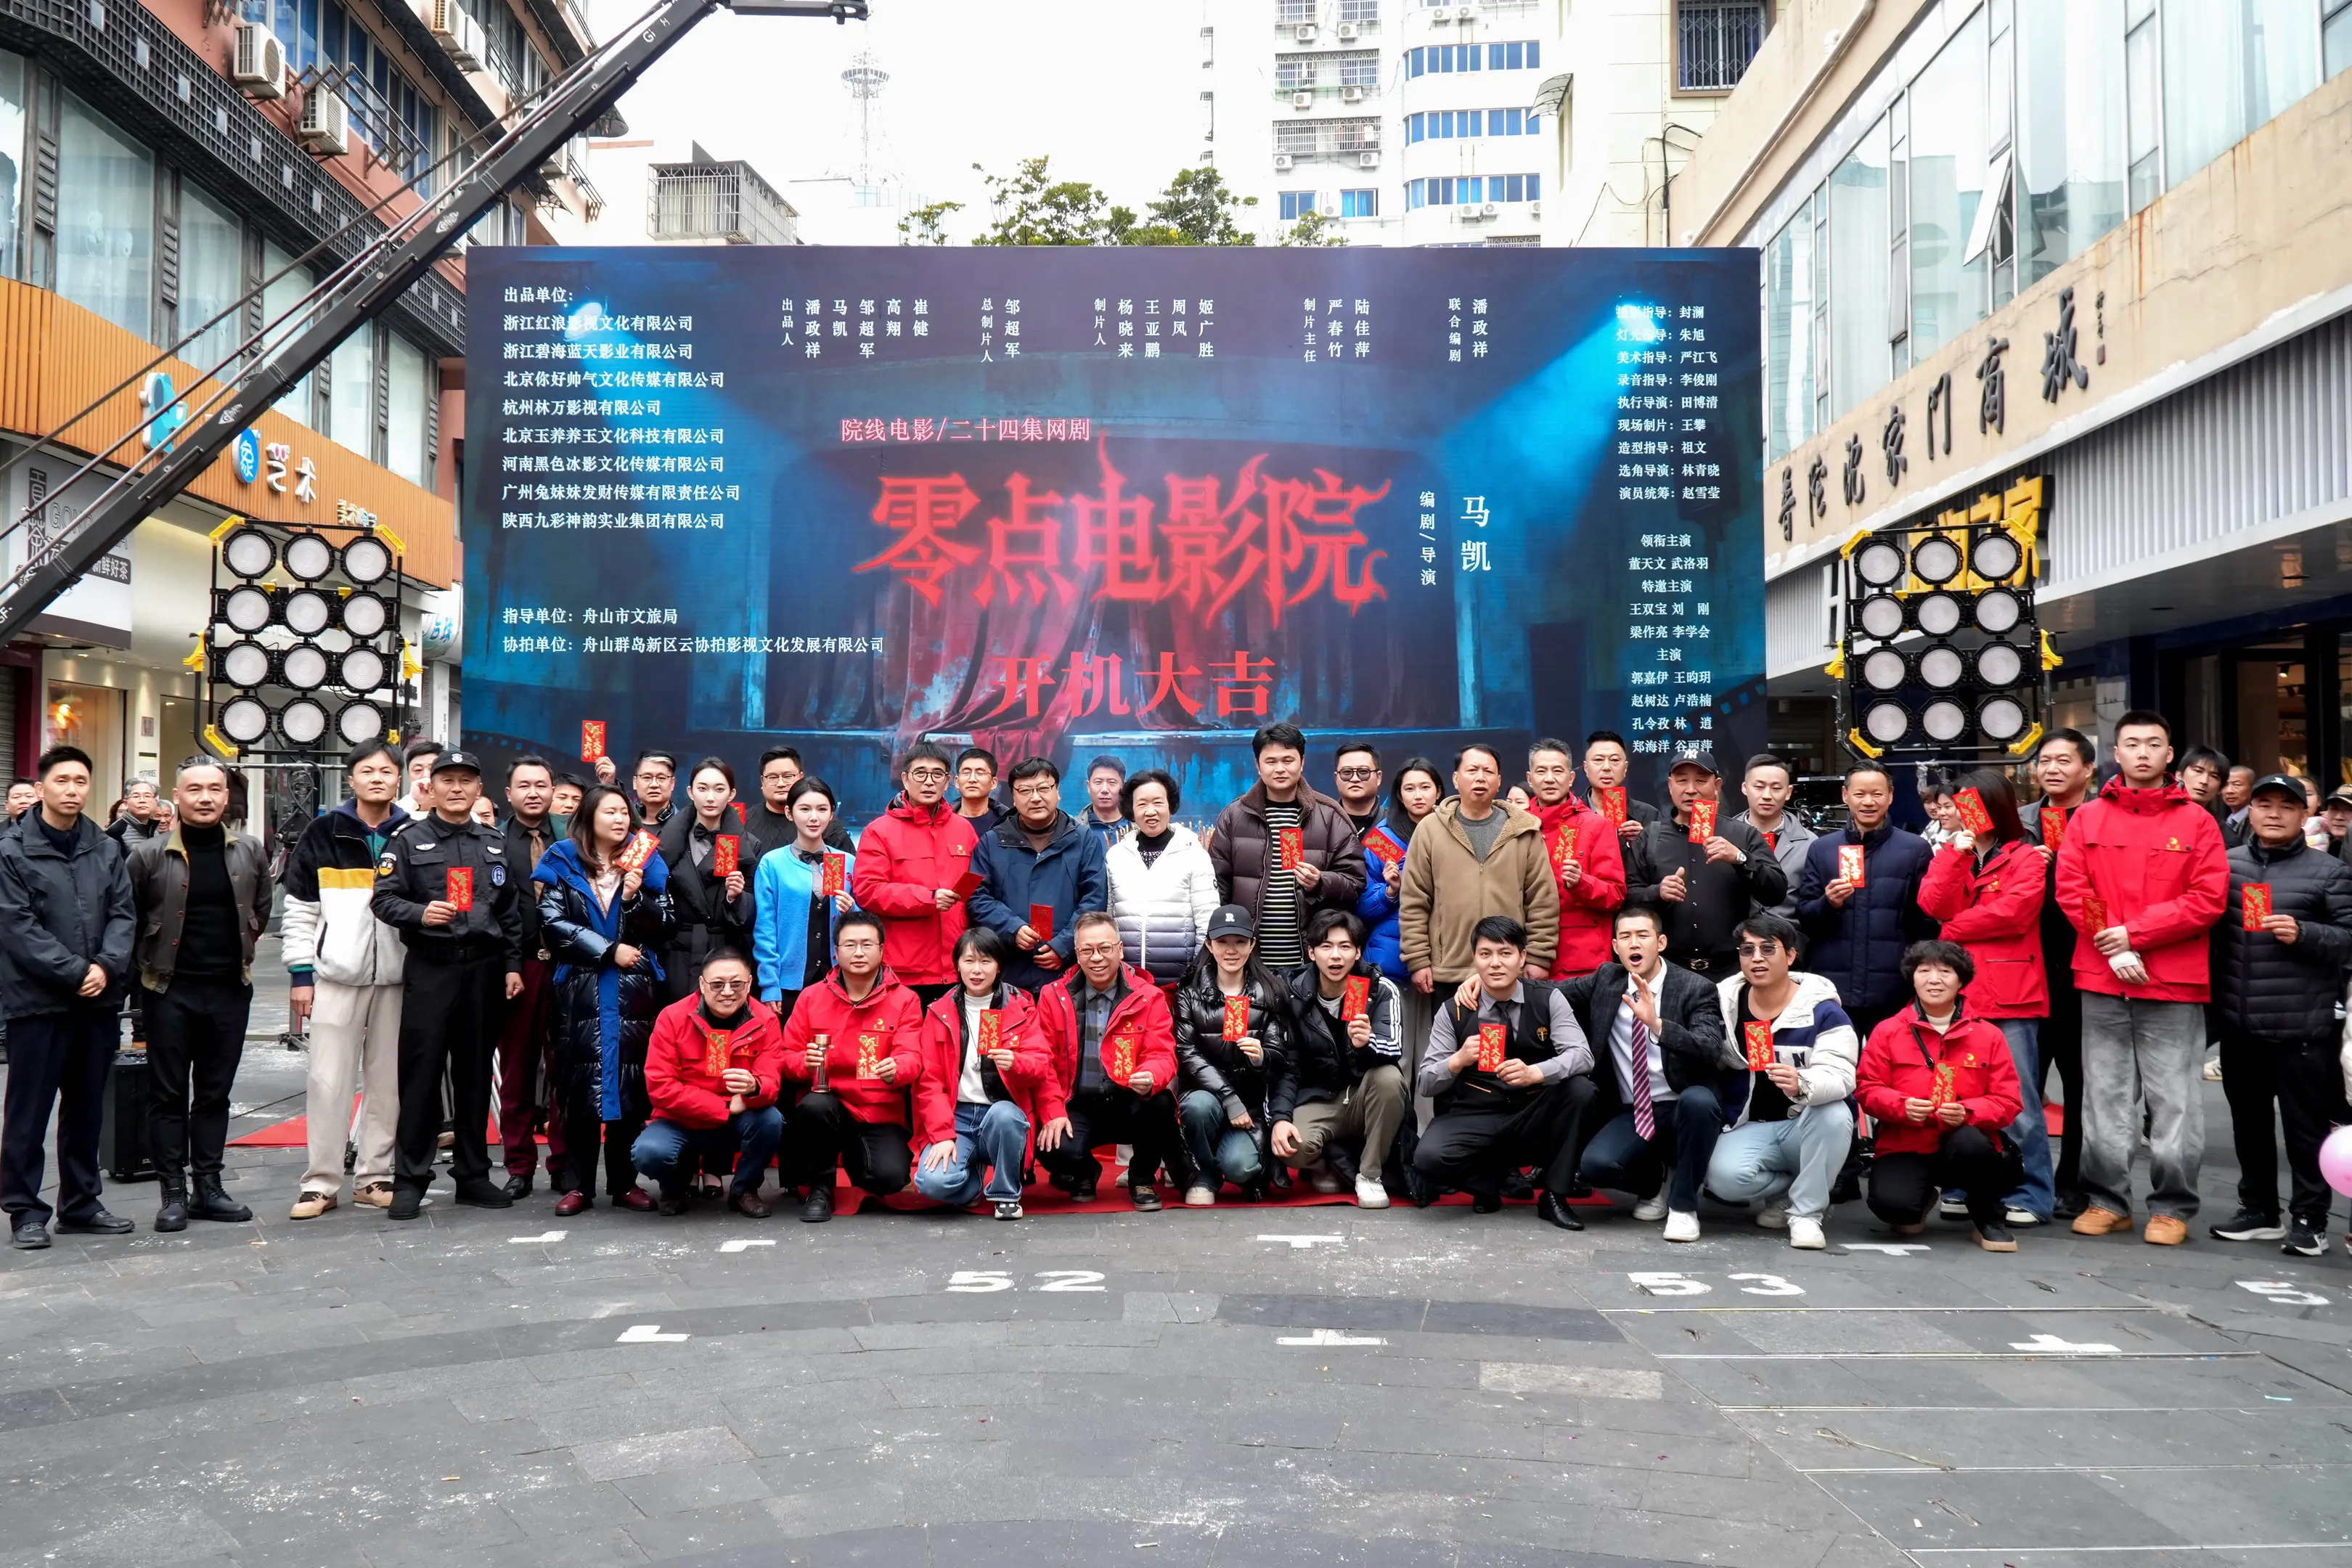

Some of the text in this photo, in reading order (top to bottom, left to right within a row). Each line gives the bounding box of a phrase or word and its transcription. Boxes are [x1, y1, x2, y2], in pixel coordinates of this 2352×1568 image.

[781, 298, 794, 346] 出品人
[832, 299, 848, 337] 马凯
[886, 298, 902, 337] 高翔
[912, 298, 929, 337] 崔健
[1093, 298, 1107, 346] 制片人
[1171, 298, 1188, 337] 周凤
[1616, 305, 1704, 319] 指导：封澜
[804, 299, 821, 359] 潘政祥
[859, 298, 875, 359] 邹超军
[980, 298, 994, 363] 总制片人
[1004, 298, 1021, 359] 邹超军
[1117, 298, 1134, 358] 杨晓来
[1144, 299, 1161, 359] 王亚鹏
[1198, 298, 1214, 358] 姬广胜
[1303, 298, 1317, 363] 制片主任
[1327, 298, 1344, 358] 严春竹
[1354, 298, 1371, 358] 陆佳萍
[1448, 298, 1461, 362] 联合编剧
[1472, 298, 1488, 358] 潘政祥
[503, 343, 693, 359] 浙江碧海蓝天影业有限公司
[503, 370, 724, 388] 北京你好帅气文化传媒有限公司
[502, 399, 661, 416] 杭州林万影视有限公司
[502, 427, 724, 444] 北京玉养养玉文化科技有限公司
[841, 417, 1091, 443] 院线电影/二十四集网剧
[502, 455, 724, 473] 河南黑色冰影文化传媒有限公司
[502, 483, 740, 501] 广州兔妹妹发财传媒有限责任公司
[502, 512, 724, 529] 陕西九彩神韵实业集团有限公司
[851, 431, 1391, 629] 零点电影院
[1461, 495, 1491, 572] 马凯
[1640, 534, 1691, 547] 领衔主演
[1628, 556, 1708, 571] 董天文 武洛羽
[1641, 579, 1692, 593] 特邀主演
[1629, 602, 1667, 616] 王双宝
[1630, 624, 1710, 639] 梁作亮 李学会
[1656, 648, 1682, 661] 主演
[988, 650, 1275, 717] 开机大吉
[1631, 671, 1669, 685] 郭嘉伊
[1631, 693, 1712, 707] 赵树达 卢浩楠
[1632, 716, 1670, 730] 孔令孜
[1632, 739, 1713, 754] 郑海洋 谷丽萍
[1225, 913, 1235, 923] R
[944, 1270, 1106, 1292] 52
[1628, 1272, 1807, 1296] 53
